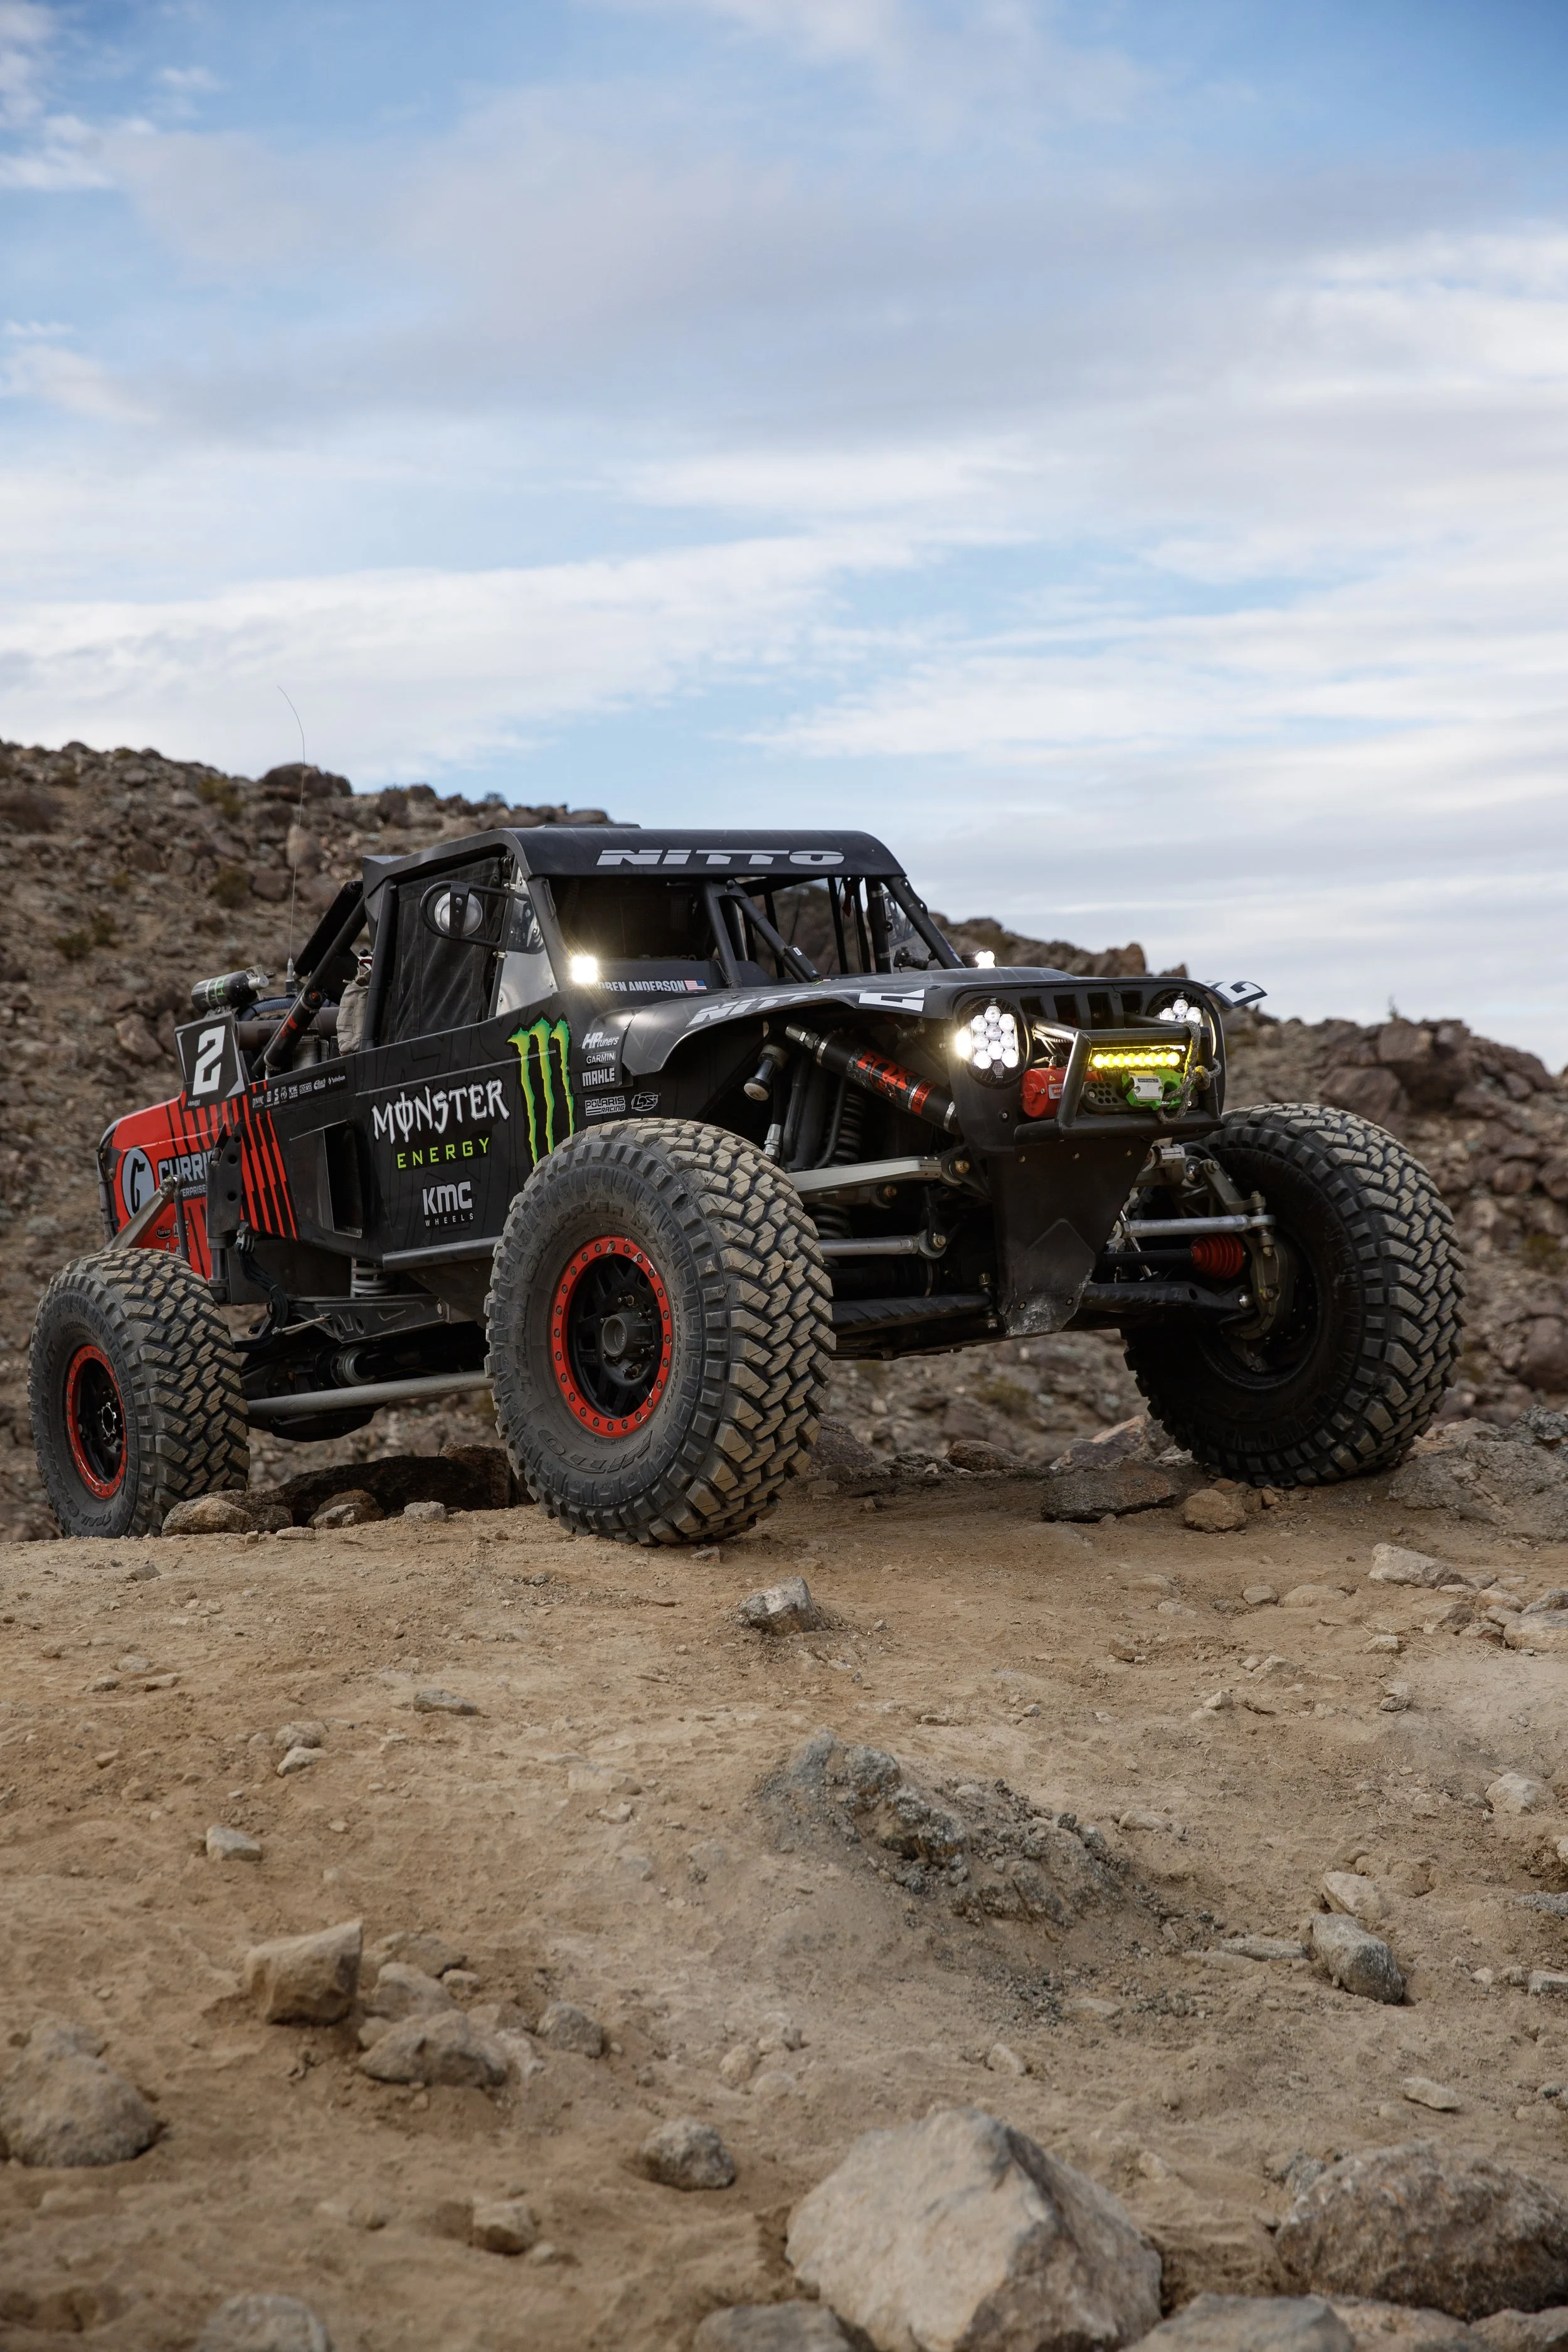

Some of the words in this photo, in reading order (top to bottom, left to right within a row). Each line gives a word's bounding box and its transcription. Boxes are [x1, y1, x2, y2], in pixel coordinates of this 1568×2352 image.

[596, 849, 845, 866] NITTO
[629, 980, 686, 992] ANDERSON
[193, 1025, 226, 1096] 2
[586, 1052, 615, 1064] GARMIN
[582, 1067, 615, 1087] MAHLE
[585, 1096, 625, 1108] POLARIS
[601, 1104, 625, 1113] RACING
[371, 1079, 510, 1144] MONSTER
[397, 1137, 489, 1168] ENERGY
[180, 1184, 207, 1197] ERPRISE
[425, 1213, 474, 1227] WHEELS
